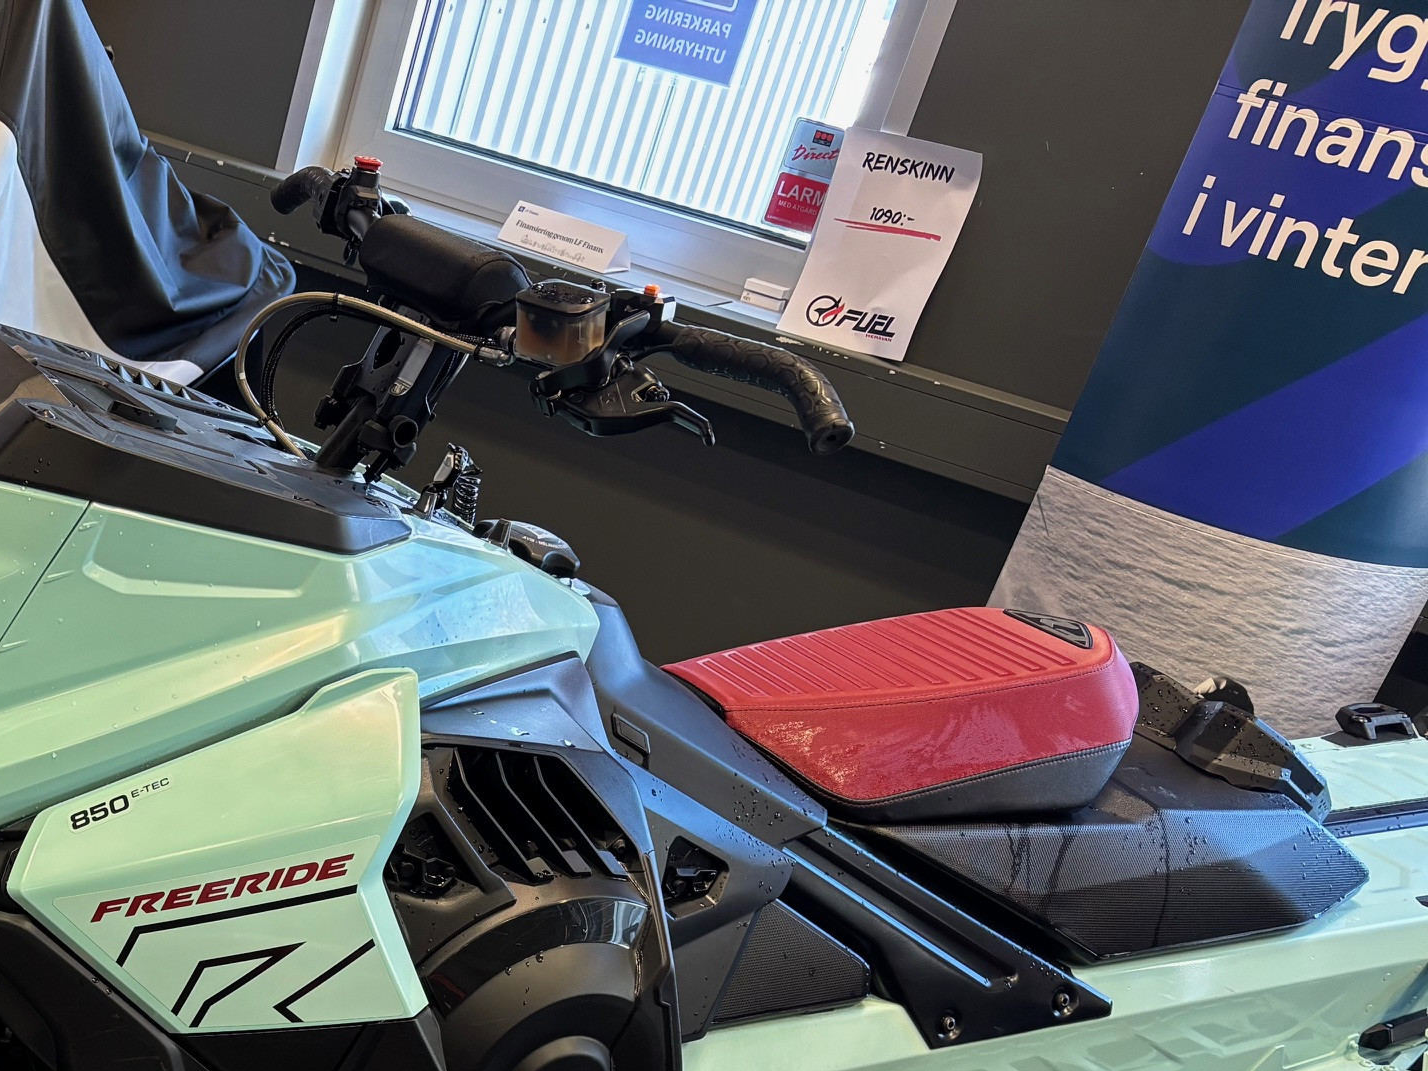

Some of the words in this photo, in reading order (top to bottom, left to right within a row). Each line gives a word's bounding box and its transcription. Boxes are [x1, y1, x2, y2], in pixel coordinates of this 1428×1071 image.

[862, 152, 955, 183] RENSKINN
[1182, 174, 1216, 236] i
[515, 219, 553, 239] Finansiering
[552, 232, 574, 244] genom
[582, 241, 604, 254] Finans
[835, 309, 896, 338] FUEL
[70, 794, 130, 830] 850
[130, 777, 170, 799] E-TEC
[90, 853, 355, 923] FREERIDE
